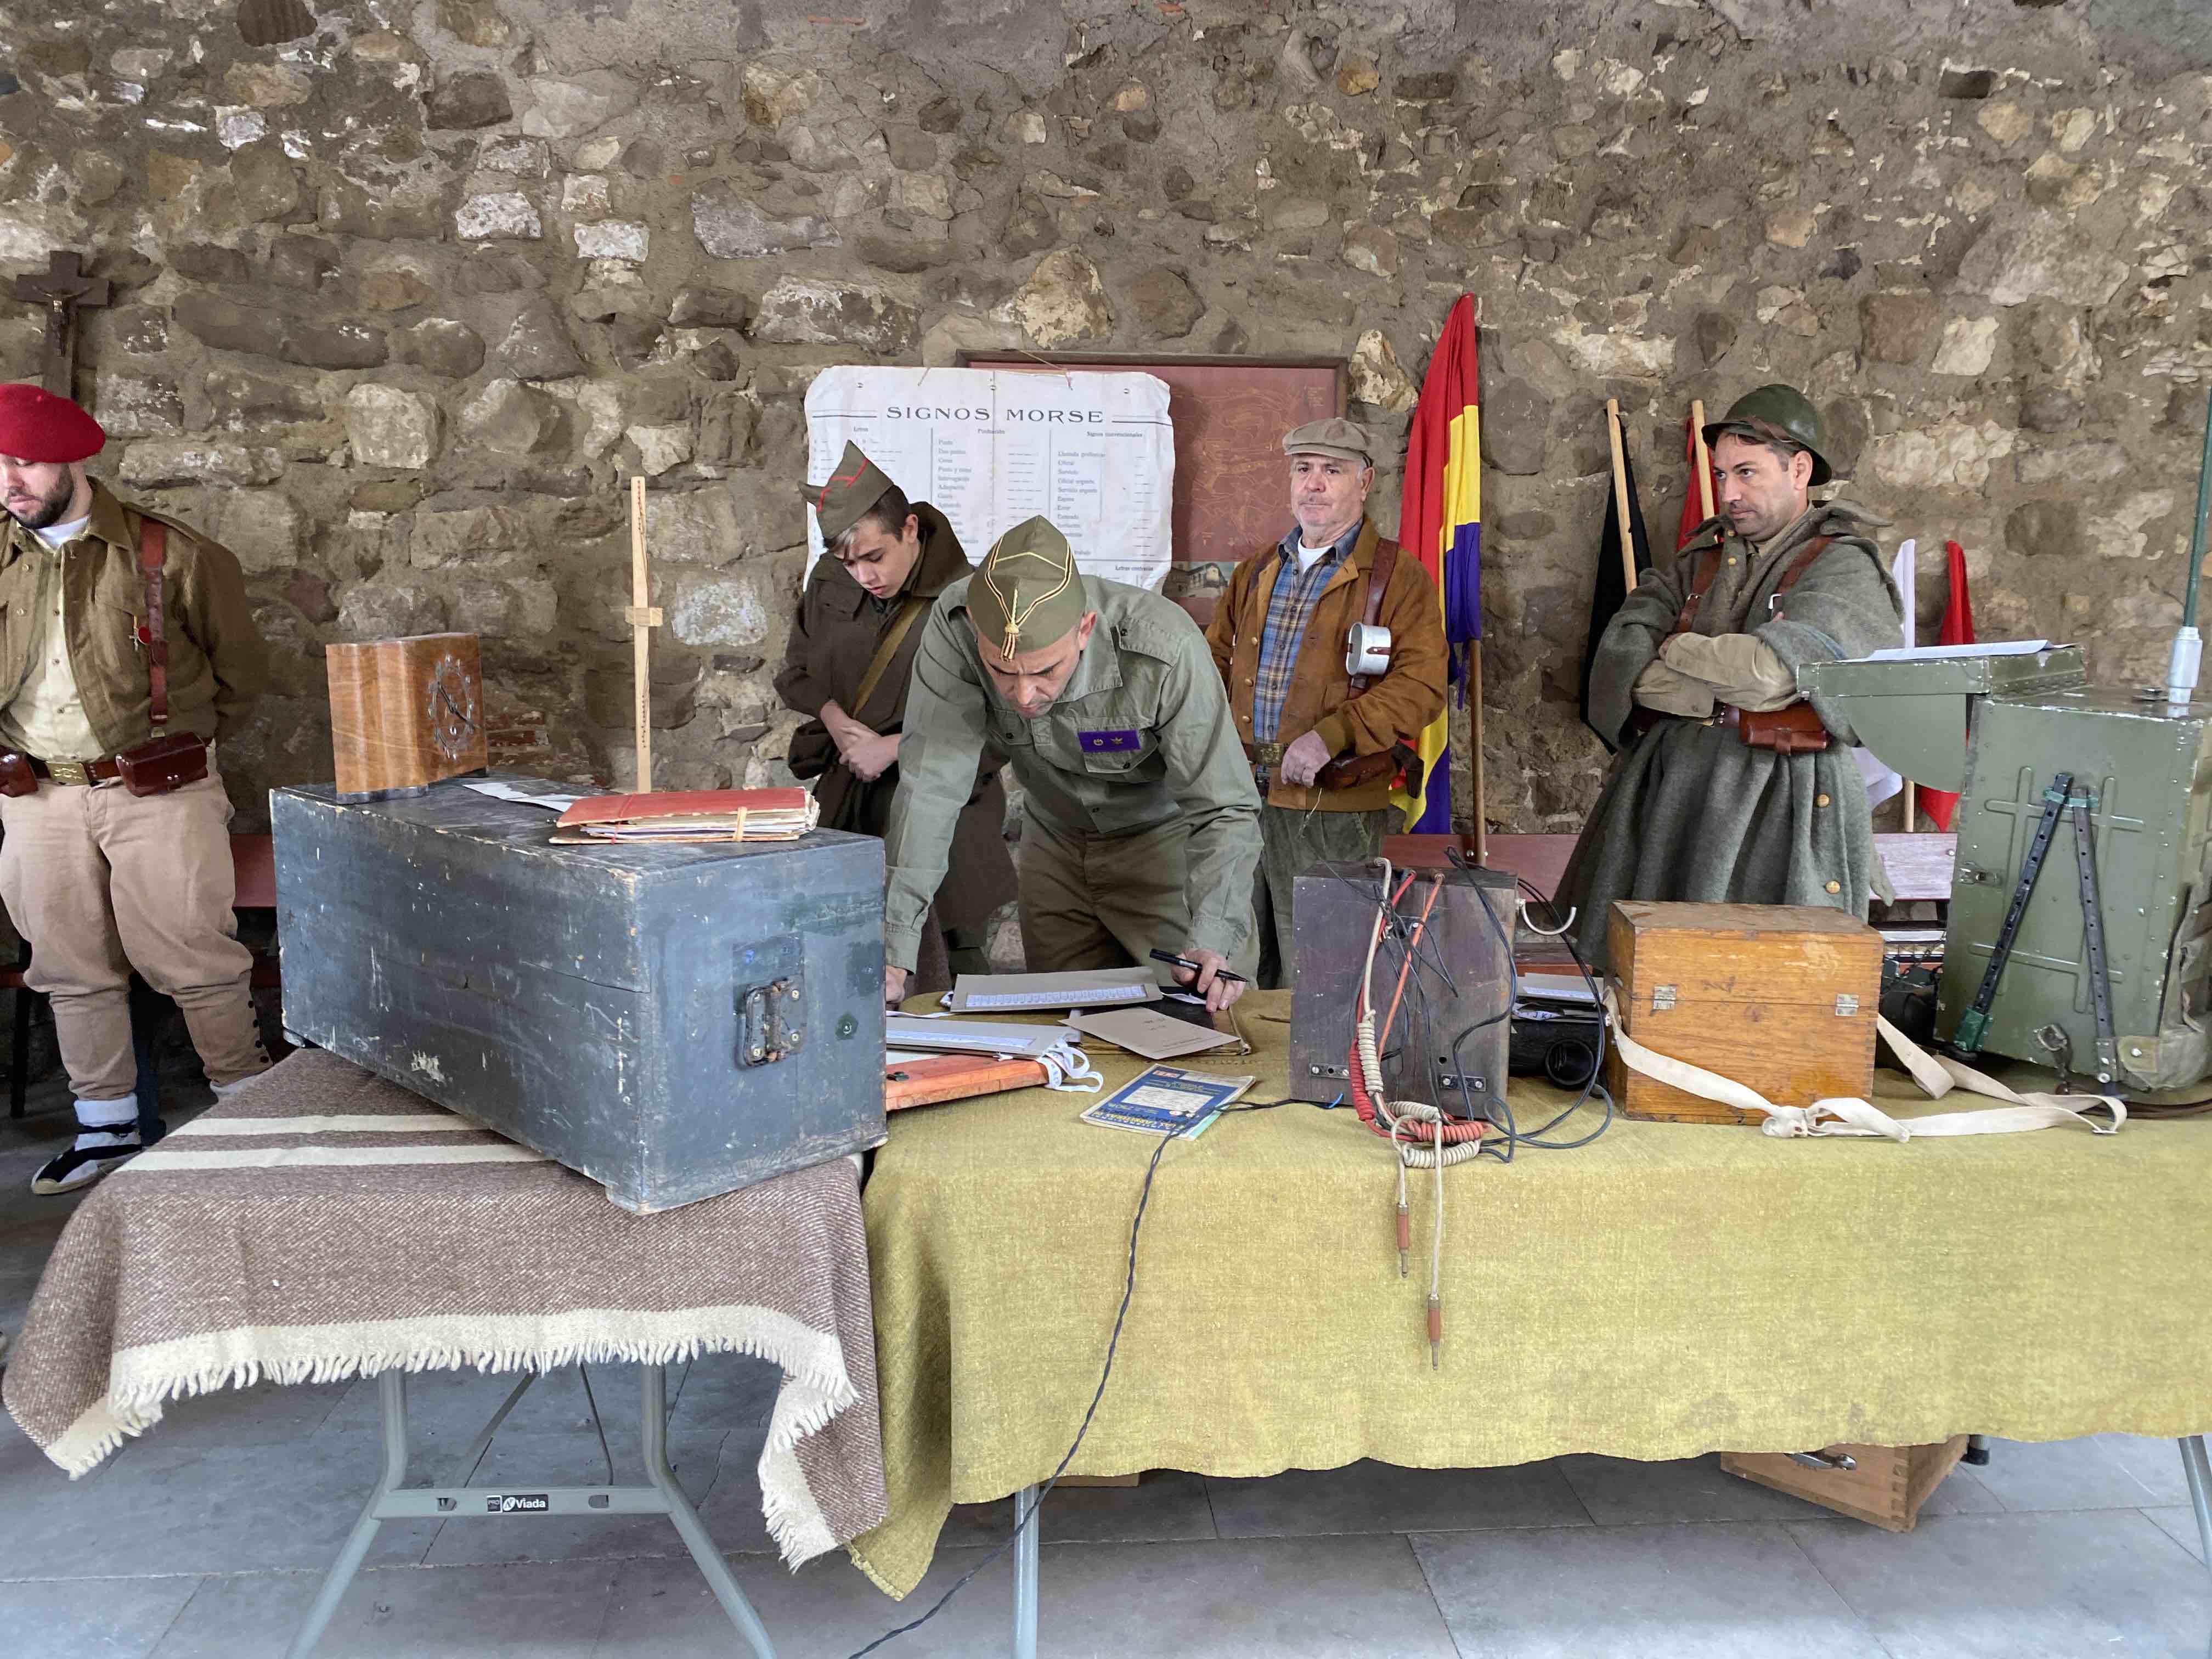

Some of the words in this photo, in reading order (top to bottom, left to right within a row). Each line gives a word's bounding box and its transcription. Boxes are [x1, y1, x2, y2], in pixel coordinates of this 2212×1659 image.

[887, 407, 990, 420] SIGNOS
[1006, 409, 1103, 425] MORSE
[516, 1497, 546, 1509] Viada
